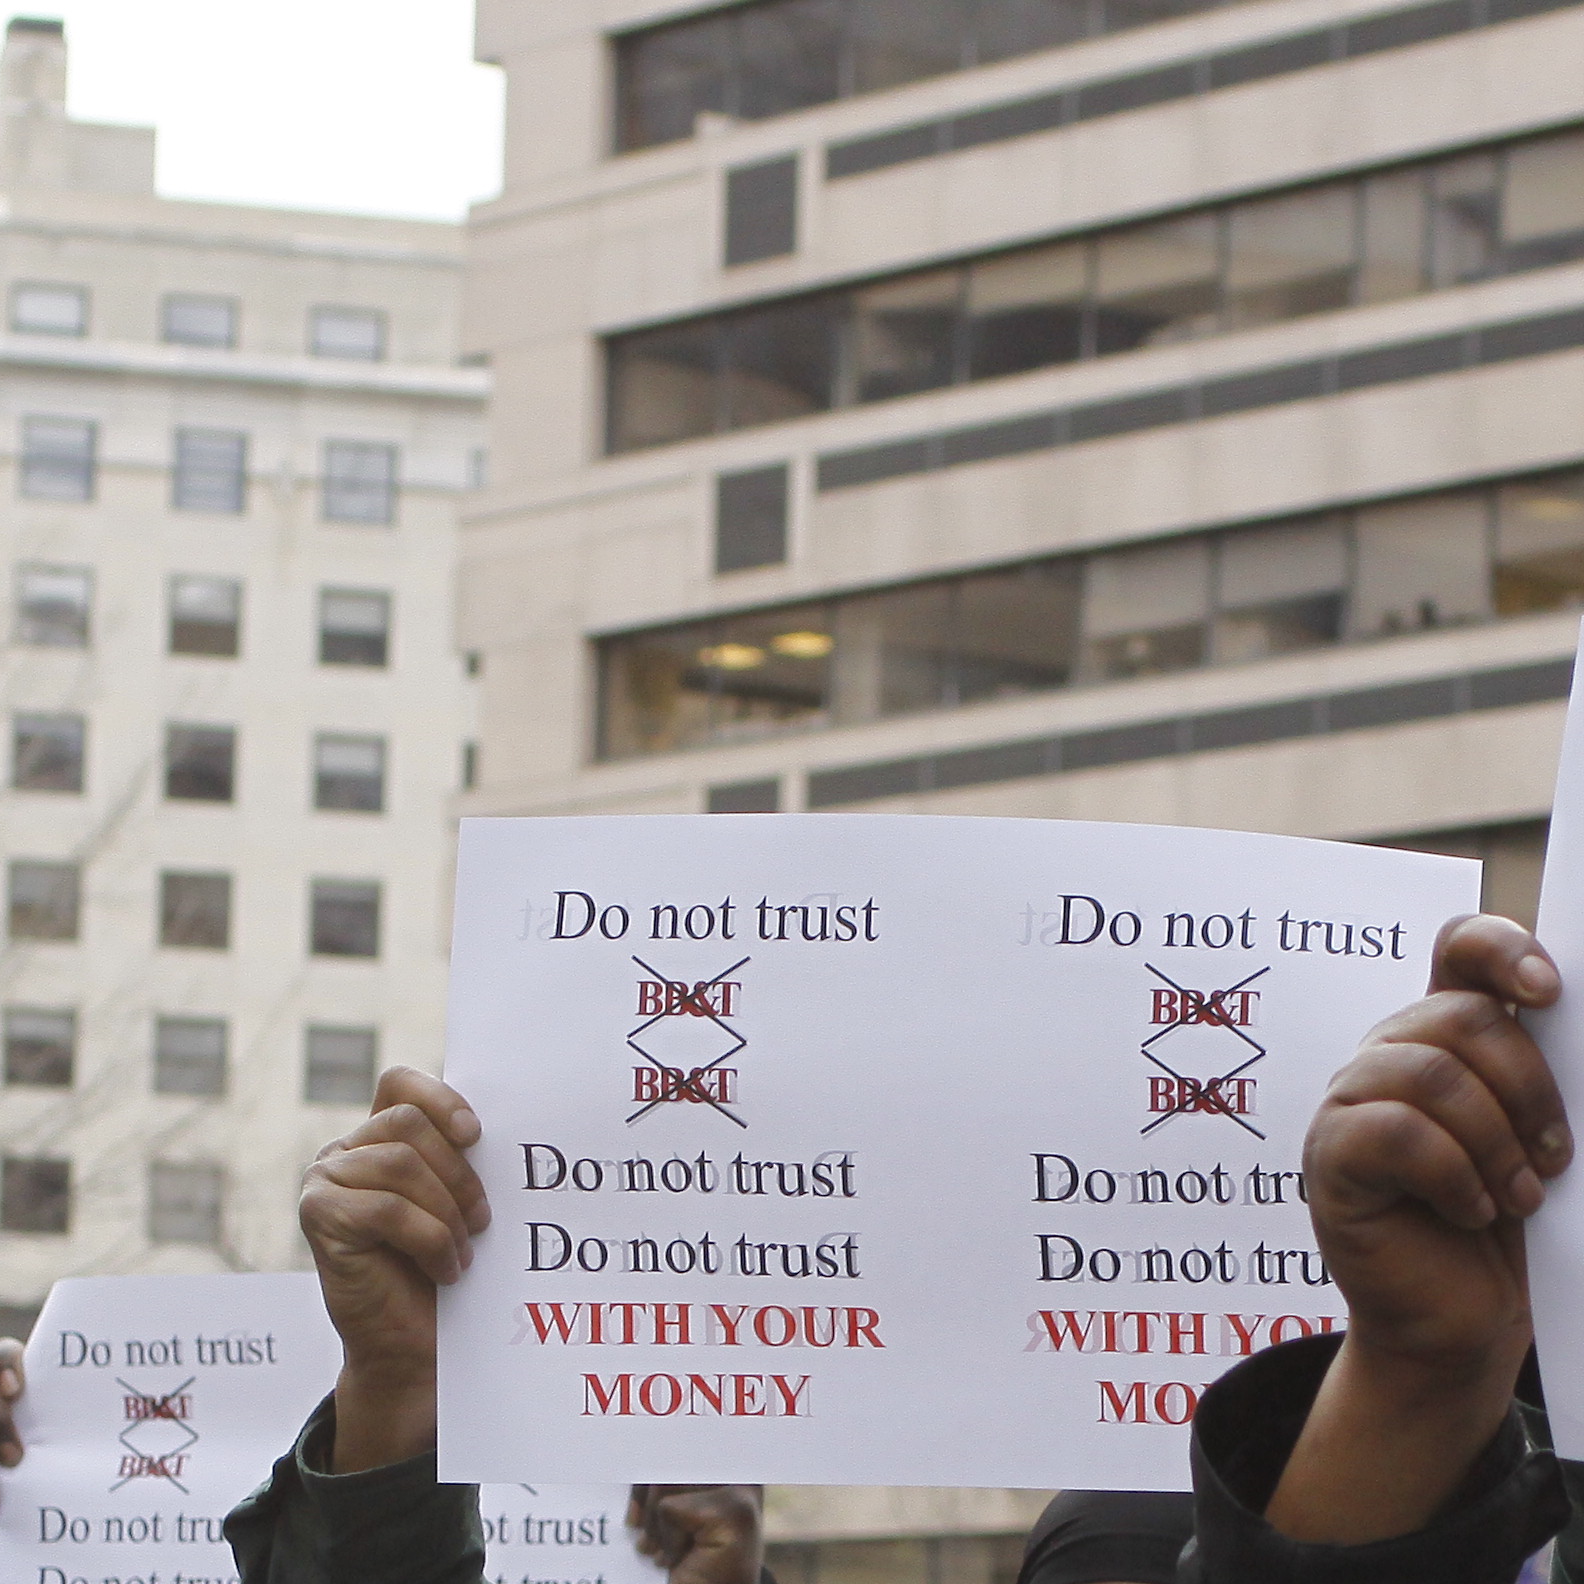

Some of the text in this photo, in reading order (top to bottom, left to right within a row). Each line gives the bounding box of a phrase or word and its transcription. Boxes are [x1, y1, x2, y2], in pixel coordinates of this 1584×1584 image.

[551, 891, 879, 942] Do not trust
[1056, 894, 1406, 961] Do not trust
[637, 981, 741, 1018] BB&T
[1150, 990, 1260, 1028] BB&T
[632, 1067, 737, 1103] BB&T
[1146, 1077, 1256, 1115] BB&T
[520, 1143, 856, 1198] Do not trust
[1031, 1153, 1117, 1204] Do
[1136, 1162, 1232, 1205] not
[525, 1222, 860, 1279] Do not trust
[1036, 1234, 1332, 1288] Do not tru
[527, 1303, 884, 1348] WITH YOUR
[1040, 1311, 1205, 1355] WITH
[60, 1331, 276, 1368] Do not trust
[580, 1373, 810, 1417] MONEY
[39, 1507, 225, 1544] Do not tru
[481, 1512, 608, 1546] ot trust
